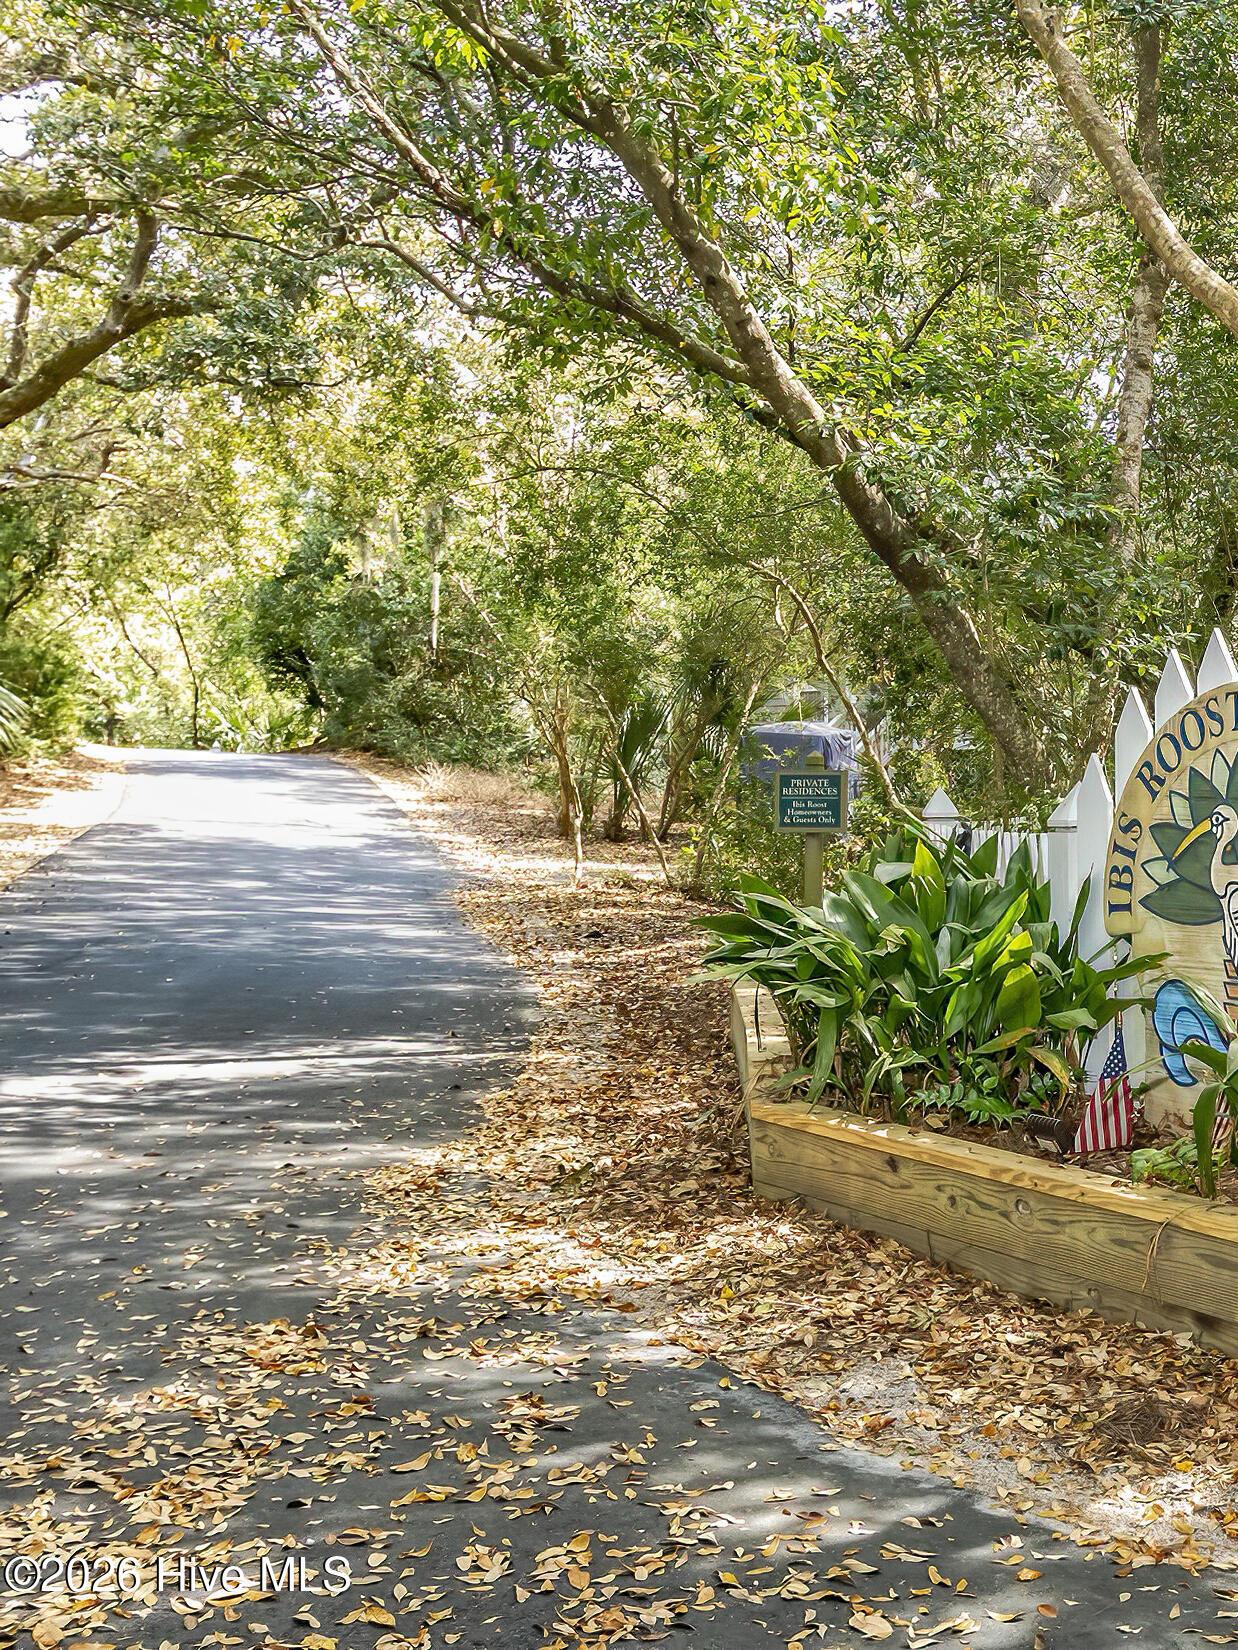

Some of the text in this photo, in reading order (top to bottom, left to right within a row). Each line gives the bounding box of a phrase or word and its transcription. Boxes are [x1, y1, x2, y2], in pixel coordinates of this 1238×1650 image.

[791, 778, 830, 787] PRIVATE
[782, 787, 838, 796] RESIDENCES
[792, 800, 827, 808] Ibis Roost
[787, 808, 833, 816] Homeowners
[783, 815, 836, 824] & Guests Only
[1107, 812, 1143, 918] IBIS
